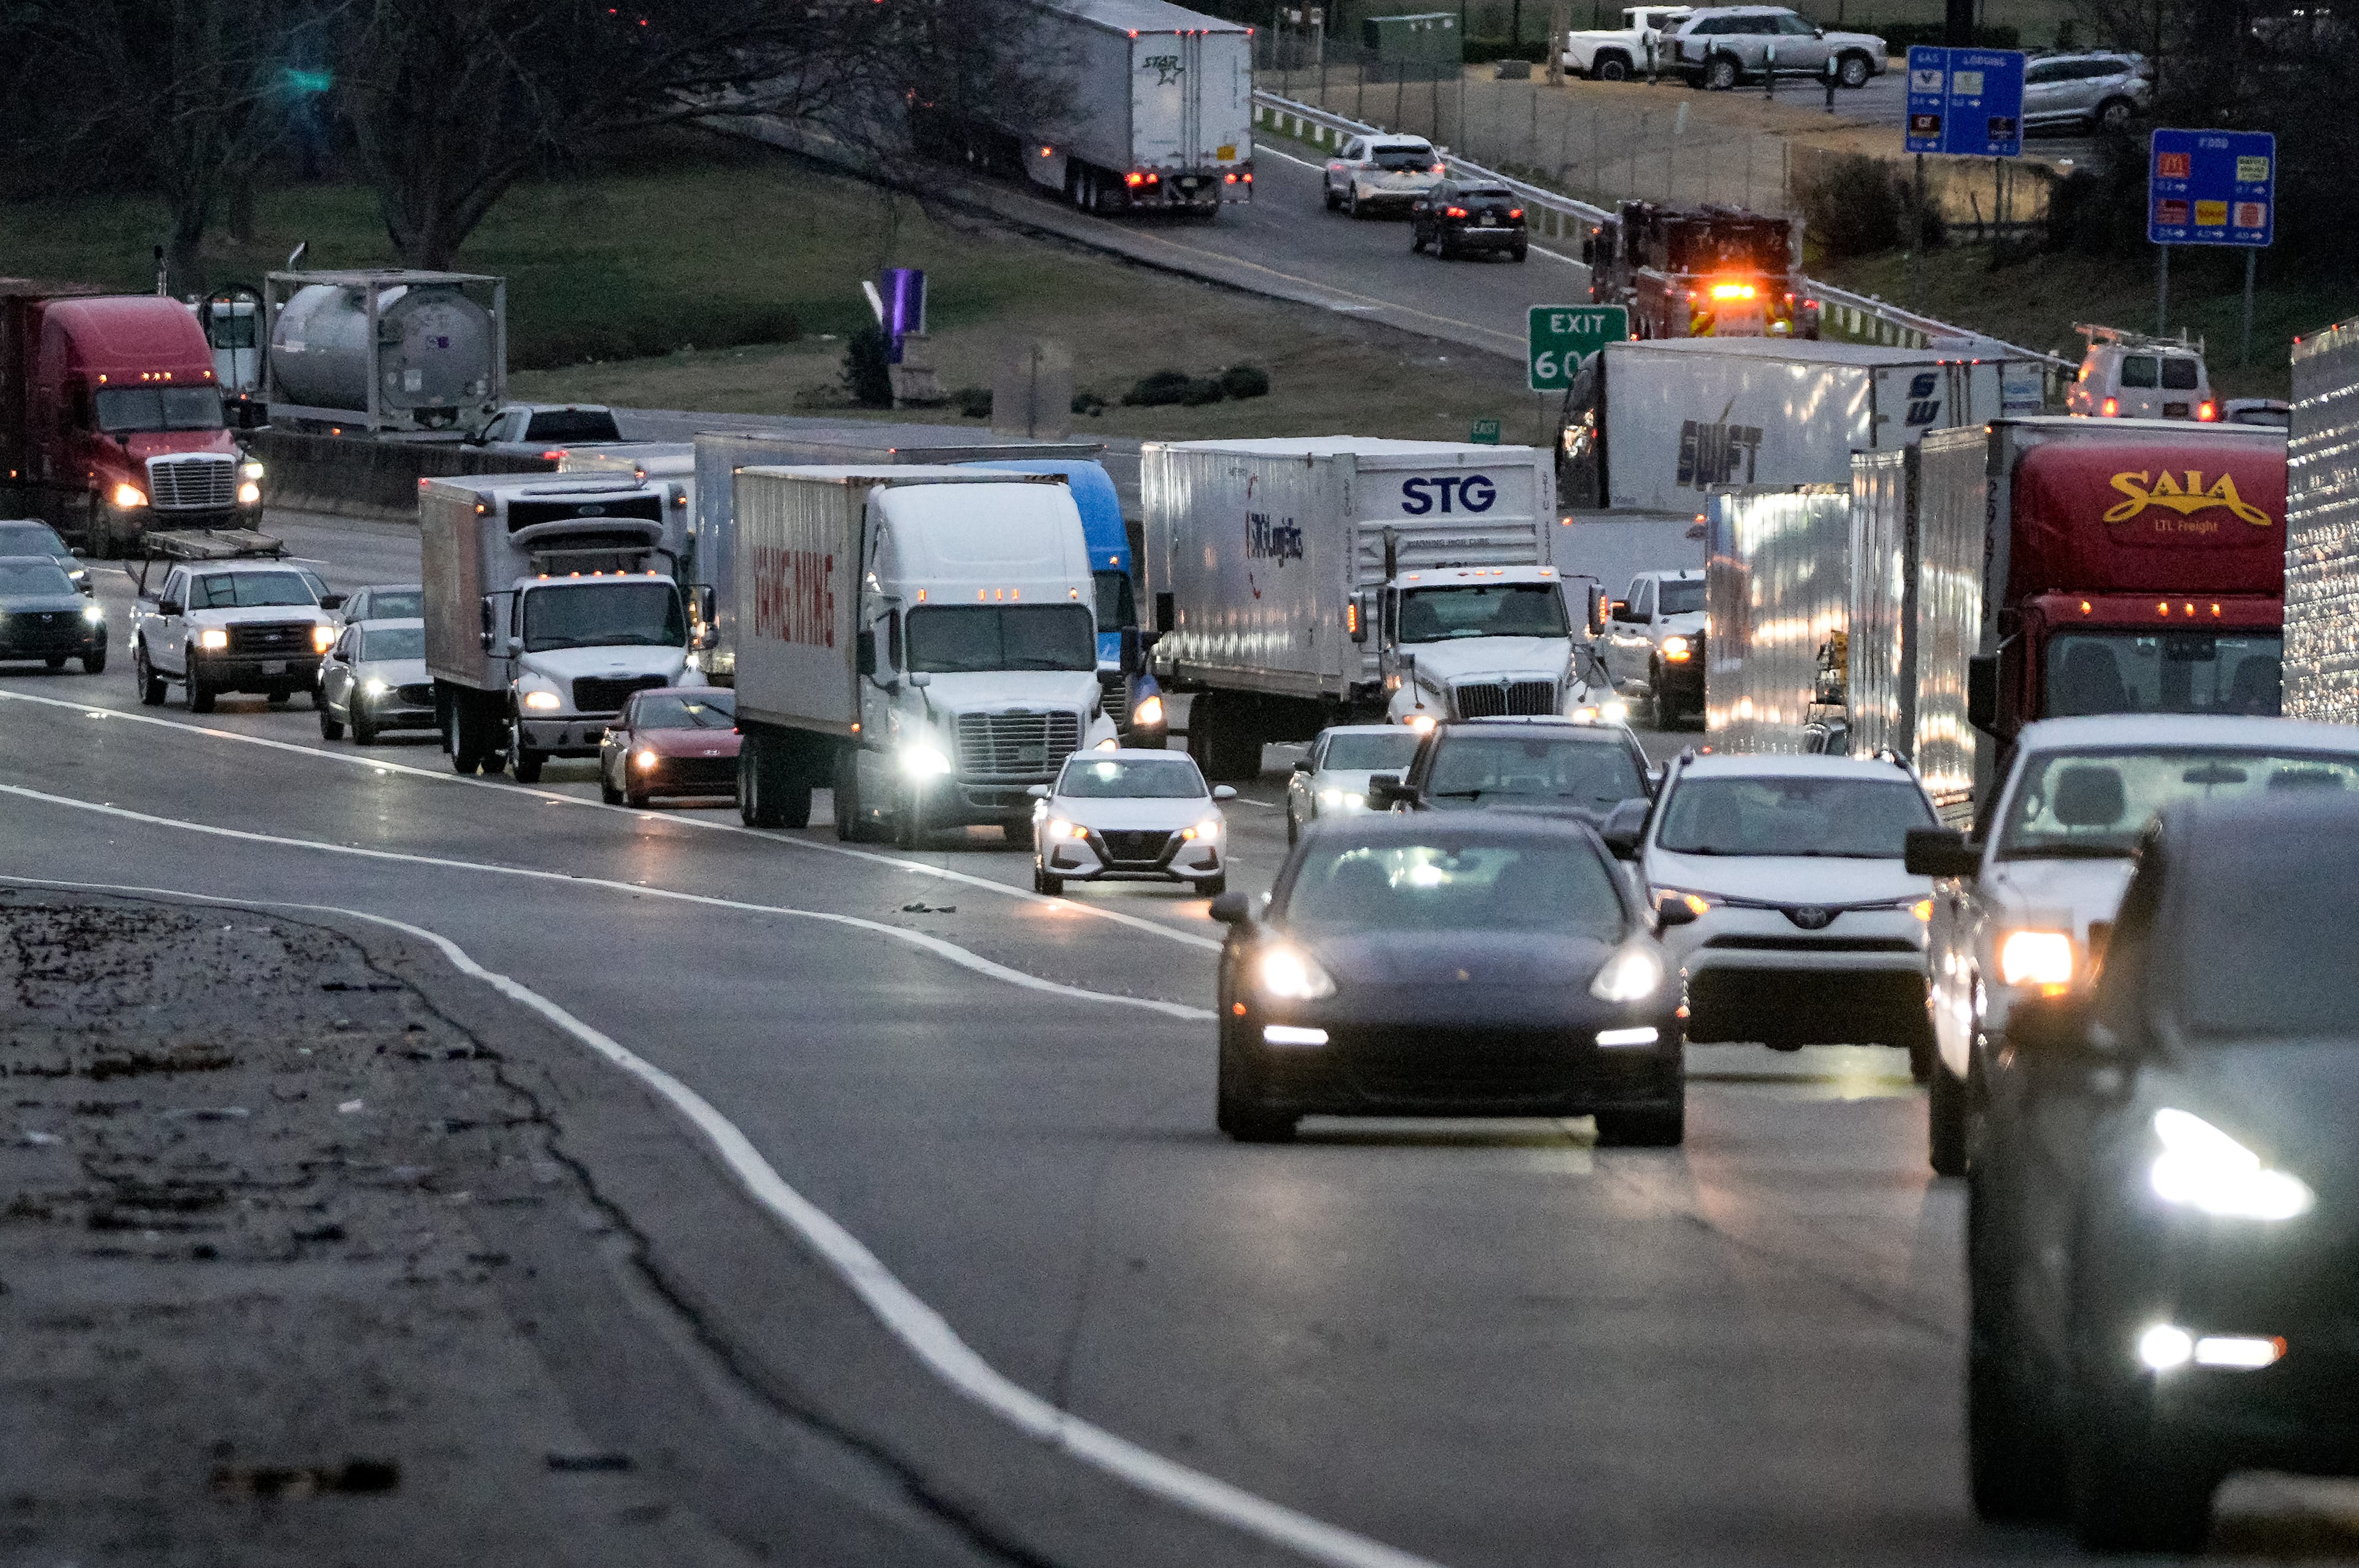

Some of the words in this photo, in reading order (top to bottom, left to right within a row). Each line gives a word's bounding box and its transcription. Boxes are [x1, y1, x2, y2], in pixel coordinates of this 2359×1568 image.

[1917, 53, 1939, 63] GAS
[1962, 55, 2008, 68] LODGING
[2199, 136, 2229, 149] FOOD
[1549, 314, 1606, 333] EXIT
[1401, 474, 1497, 515] STG
[2102, 470, 2273, 526] SAIA
[2155, 519, 2172, 531] LTL
[2178, 520, 2219, 534] Freight
